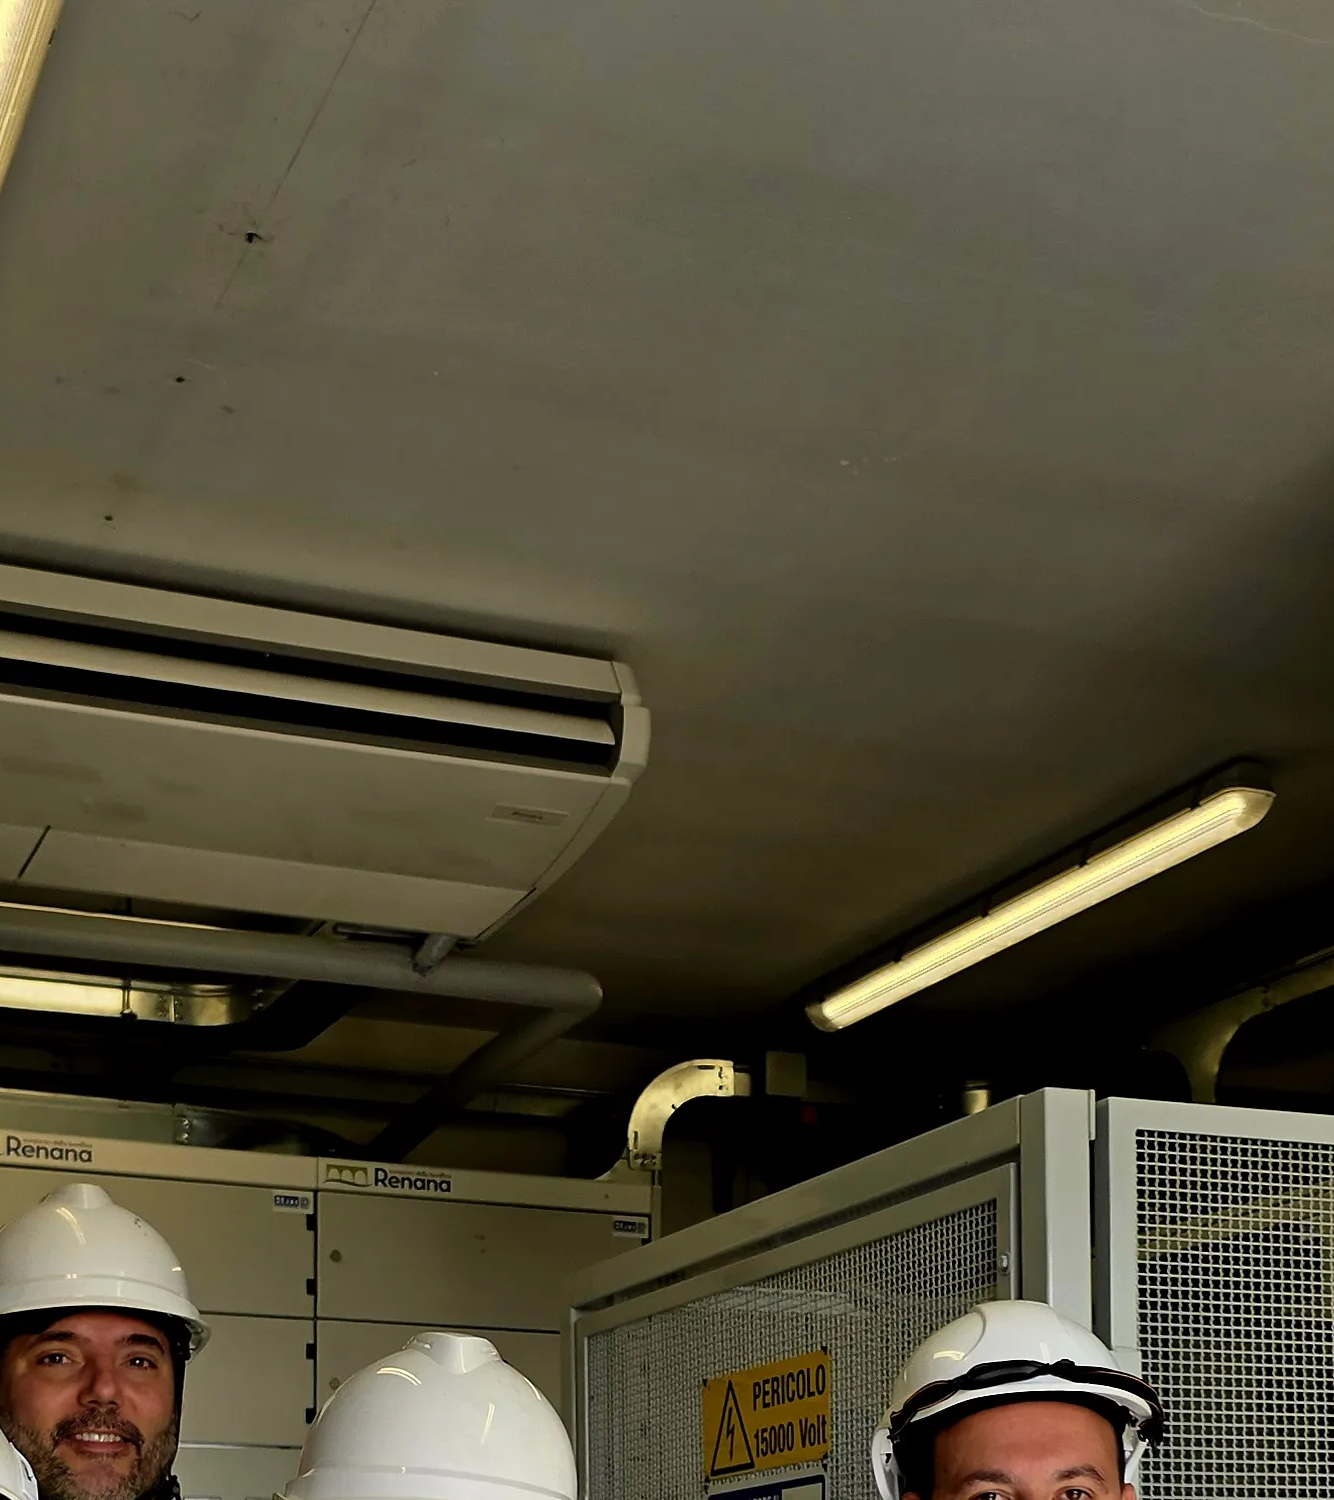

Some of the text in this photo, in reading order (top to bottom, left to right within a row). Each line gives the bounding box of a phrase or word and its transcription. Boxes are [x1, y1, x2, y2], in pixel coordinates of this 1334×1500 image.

[6, 1135, 93, 1163] Renana
[374, 1167, 451, 1193] Renana
[752, 1364, 826, 1411] PERICOLO
[753, 1414, 827, 1458] 15000 Volt
